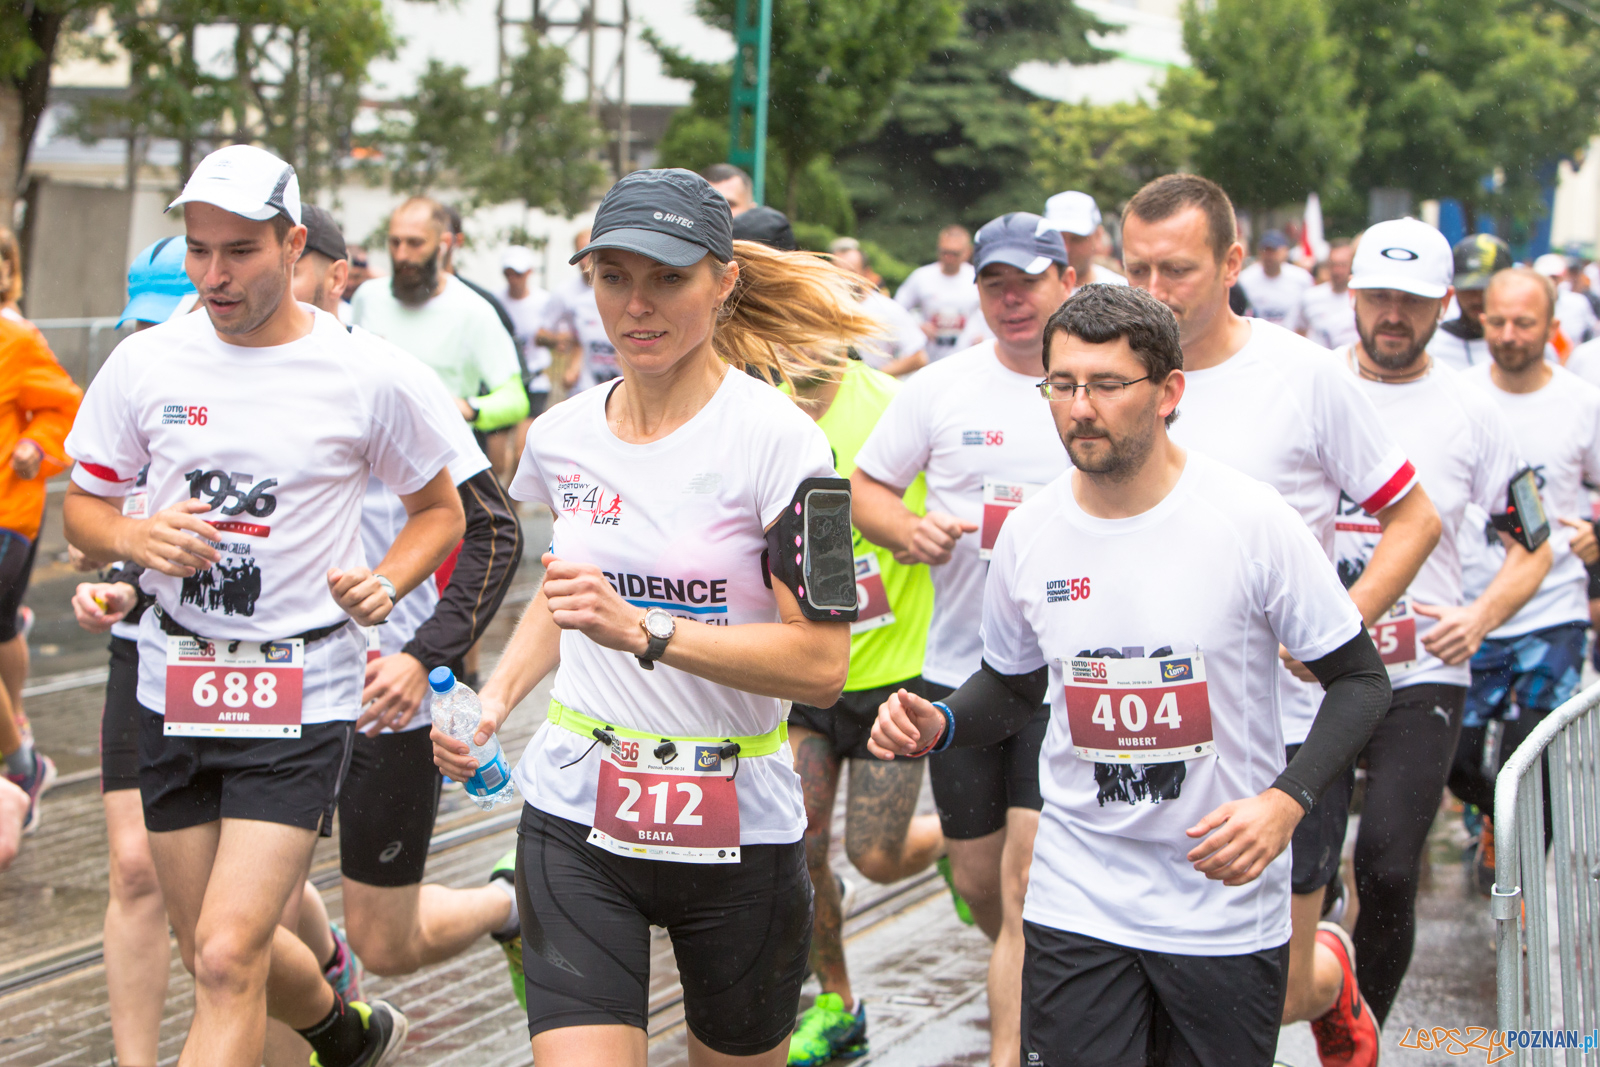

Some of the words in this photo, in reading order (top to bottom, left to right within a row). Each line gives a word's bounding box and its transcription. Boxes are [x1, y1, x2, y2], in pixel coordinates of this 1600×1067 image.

[663, 213, 694, 228] HI-TEC
[163, 405, 184, 413] LOTTO
[556, 473, 581, 484] KLUB
[184, 468, 278, 518] 1956
[582, 485, 600, 508] 4
[594, 515, 621, 526] LIFE
[1046, 580, 1066, 590] LOTTO
[192, 671, 278, 708] 688
[218, 712, 250, 721] ARTUR
[1091, 691, 1182, 732] 404
[1118, 737, 1157, 746] HUBERT
[615, 778, 703, 826] 212
[638, 830, 674, 842] BEATA
